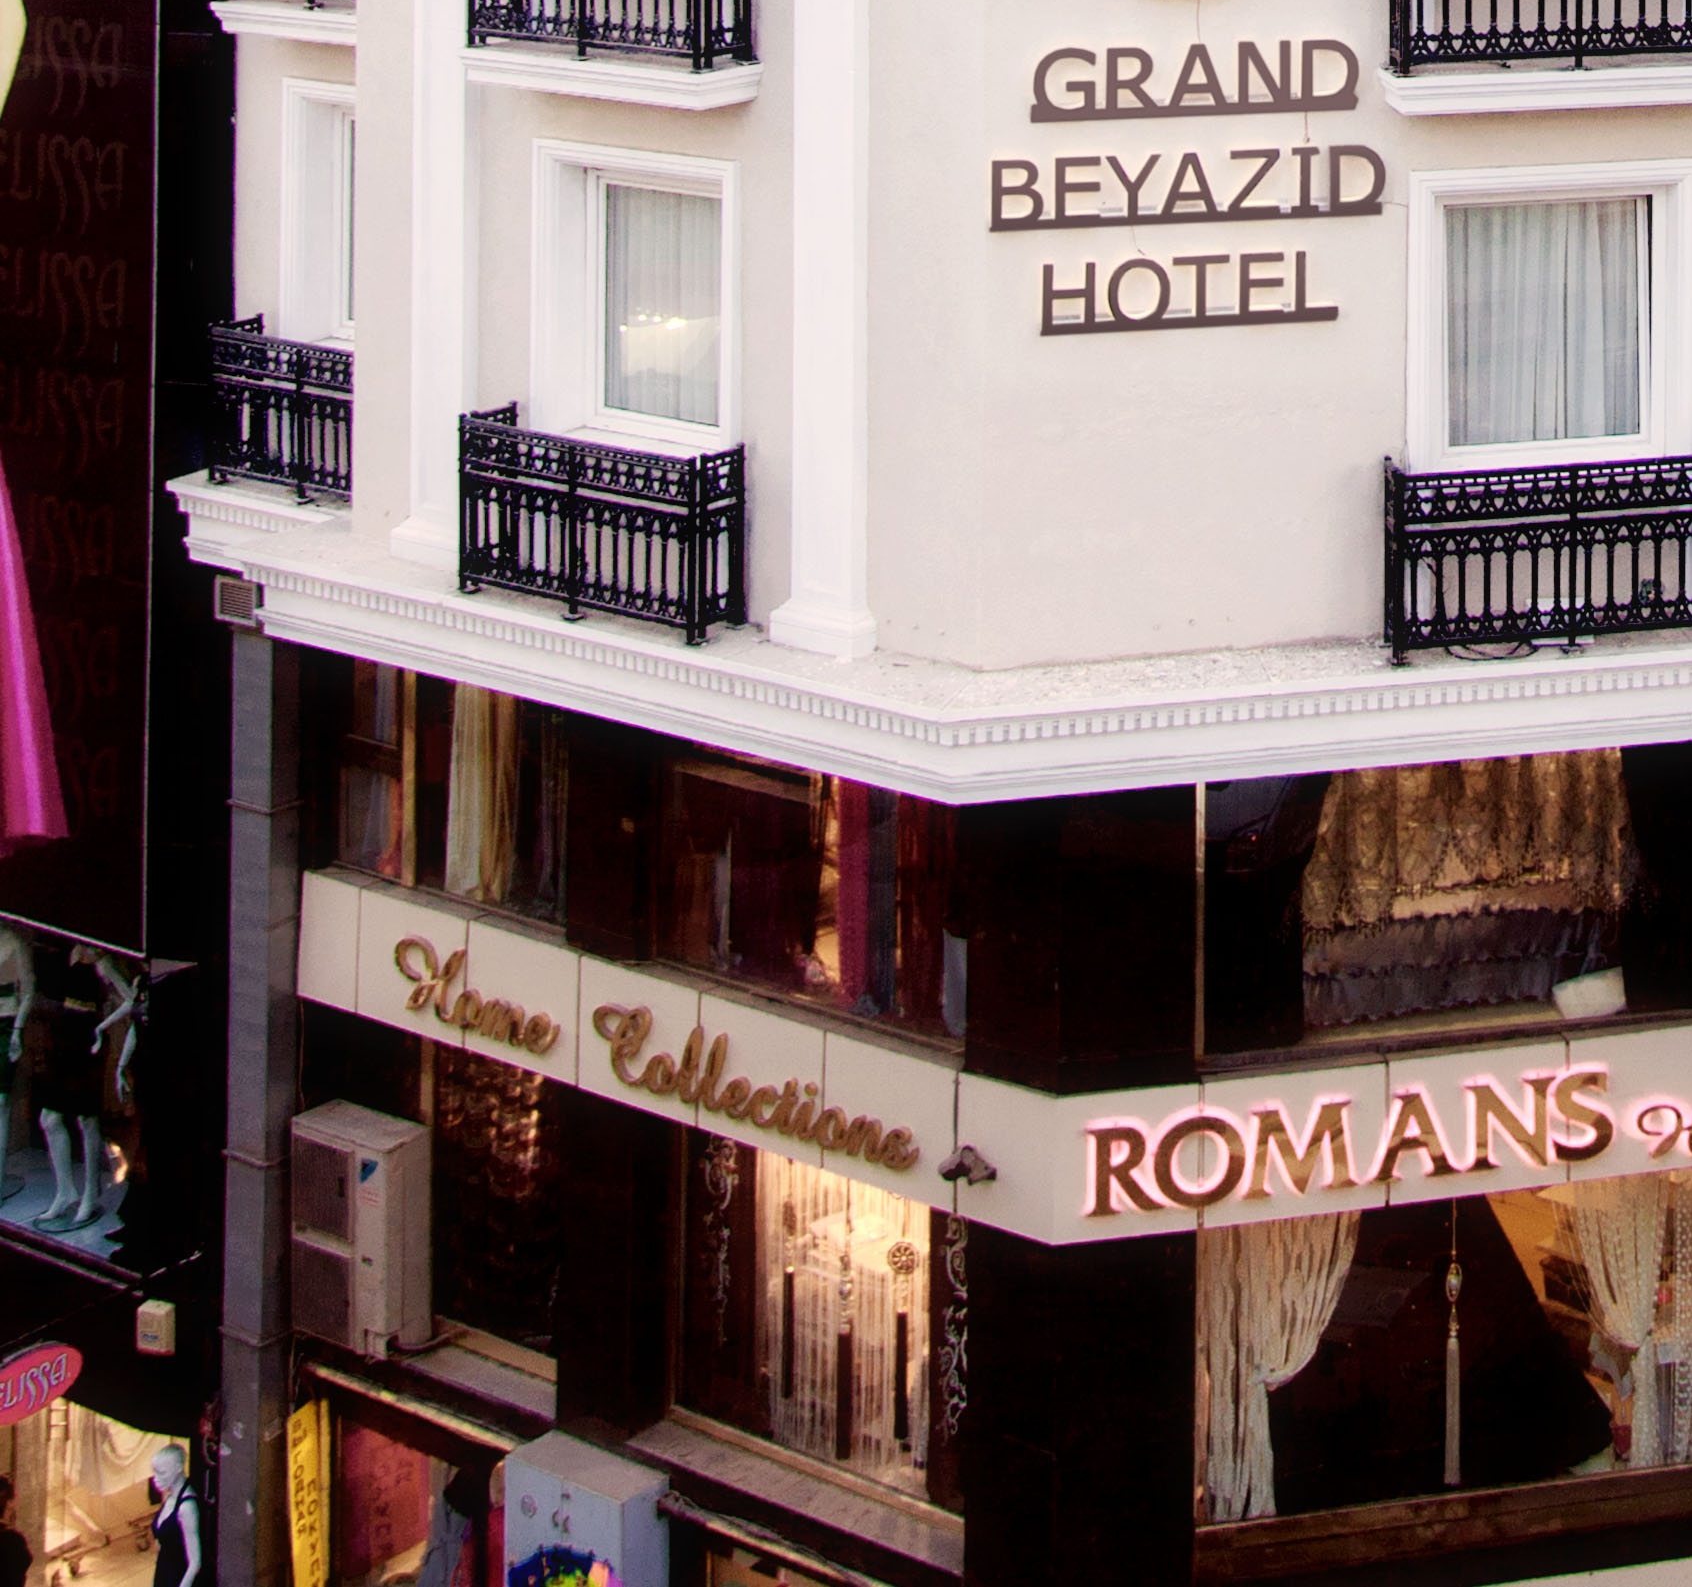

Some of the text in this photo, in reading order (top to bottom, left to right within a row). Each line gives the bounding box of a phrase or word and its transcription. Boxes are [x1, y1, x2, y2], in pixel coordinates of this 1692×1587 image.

[1031, 38, 1360, 123] GRAND
[990, 144, 1386, 232] BEYAZID
[1041, 250, 1339, 336] HOTEL
[394, 934, 920, 1171] Home Collections
[1083, 1069, 1615, 1217] ROMANS
